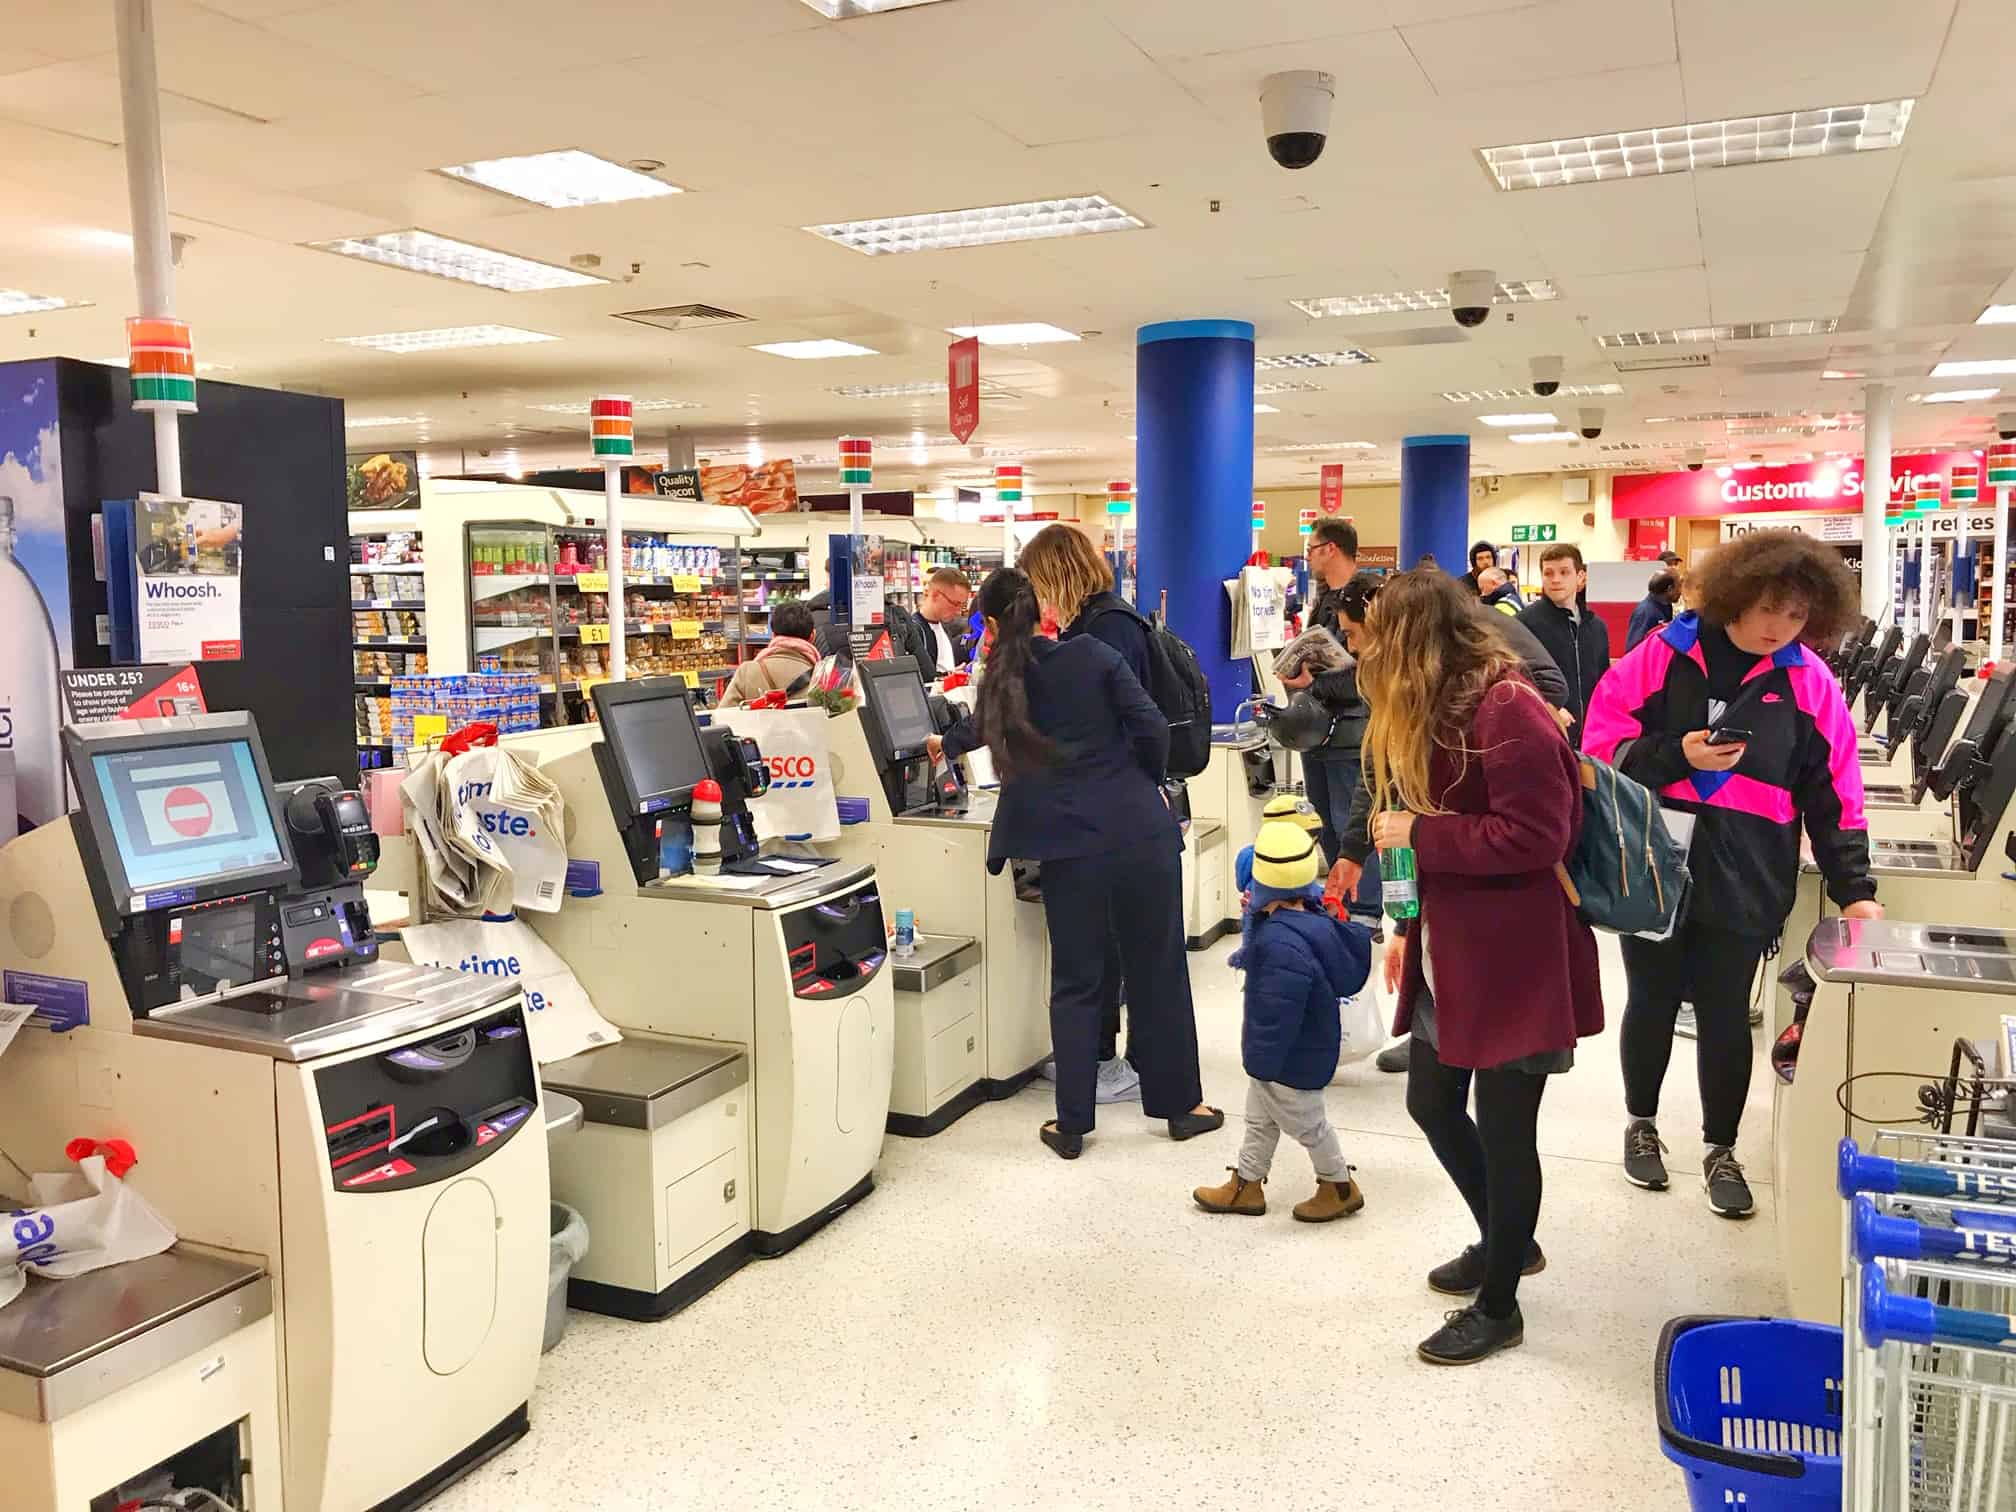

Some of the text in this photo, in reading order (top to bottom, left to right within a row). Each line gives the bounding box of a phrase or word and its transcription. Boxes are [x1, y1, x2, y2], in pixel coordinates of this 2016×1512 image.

[659, 474, 694, 487] Quality
[664, 487, 696, 497] bacon
[1721, 477, 1836, 503] Custom
[1726, 521, 1802, 539] Tobo
[145, 581, 222, 599] Whoosh.
[591, 628, 604, 642] £1
[66, 671, 144, 688] UNDER 25?
[176, 681, 197, 693] 16+
[476, 810, 536, 837] ste.
[1954, 1227, 2016, 1253] TE
